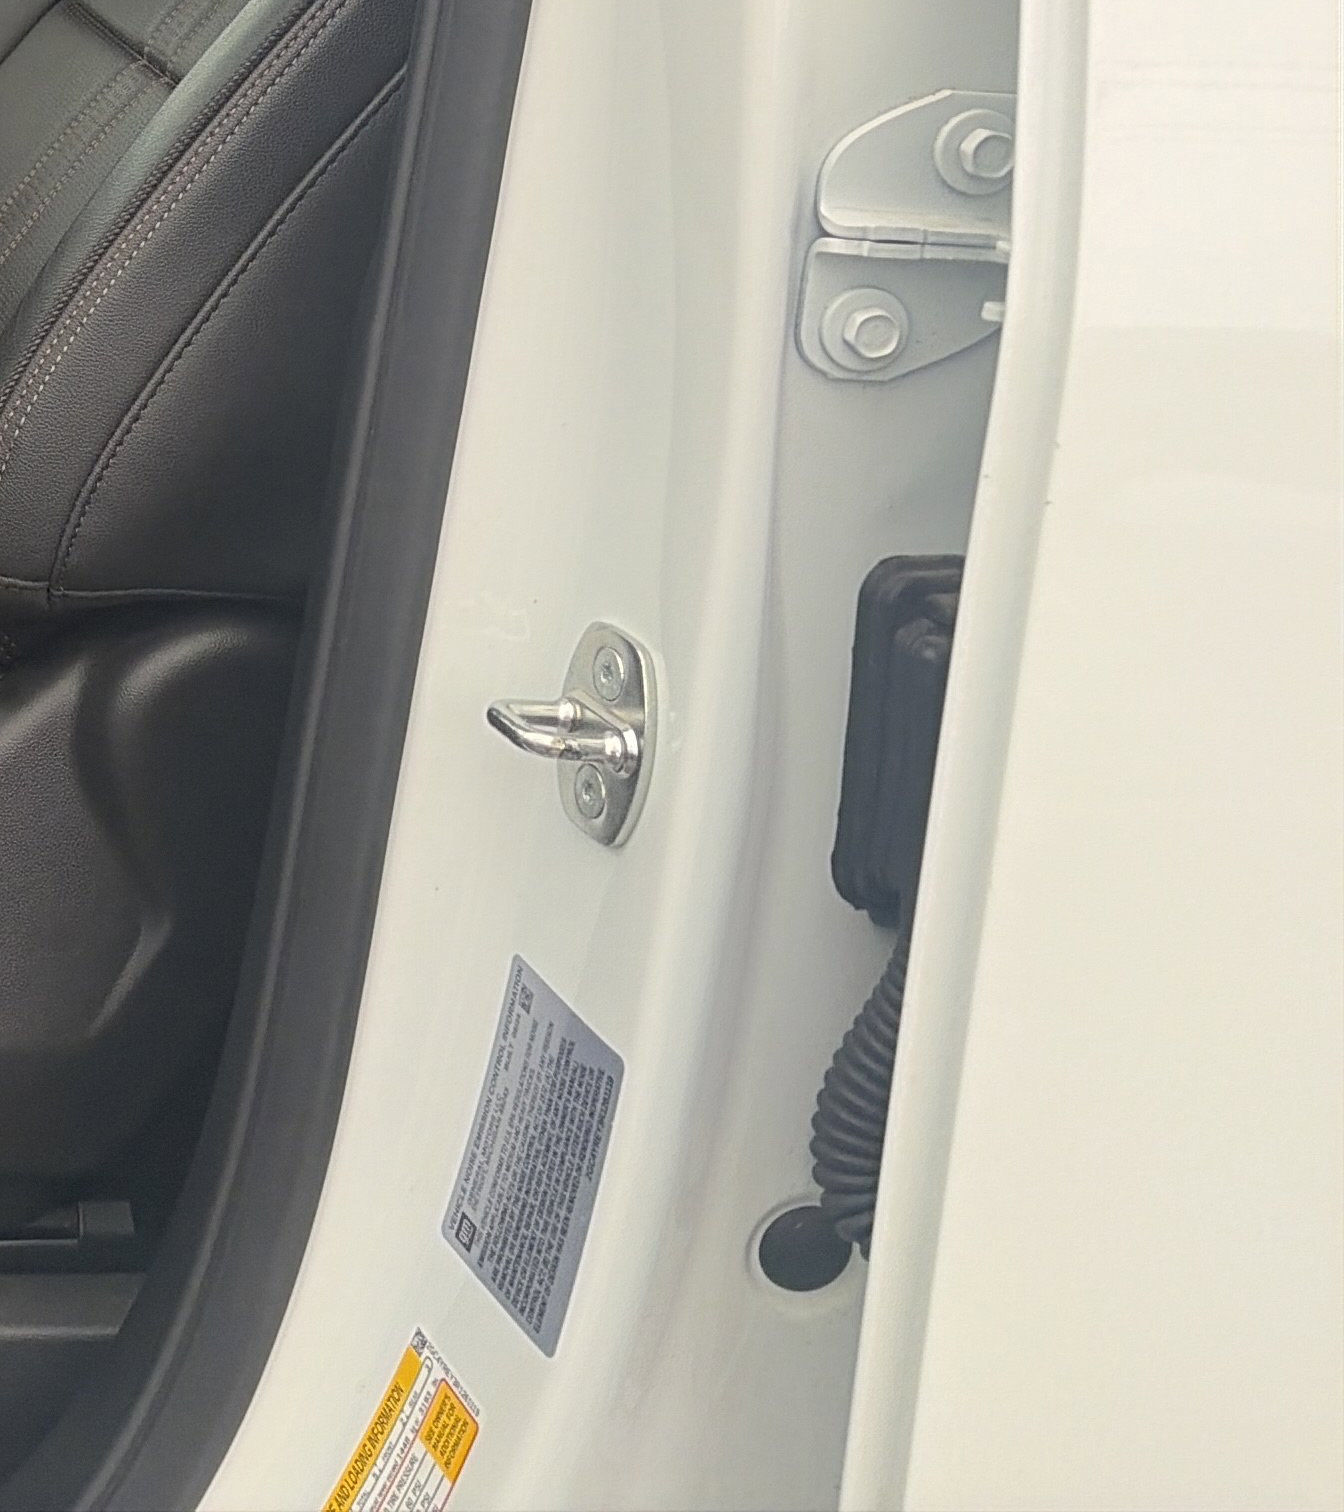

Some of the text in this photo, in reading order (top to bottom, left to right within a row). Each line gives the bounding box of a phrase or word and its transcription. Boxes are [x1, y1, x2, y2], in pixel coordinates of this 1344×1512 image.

[449, 965, 524, 1232] VEHICLE NOISE EMISSION CONTROL INFORMATION
[334, 1382, 404, 1512] AND LOADING INFORMATION
